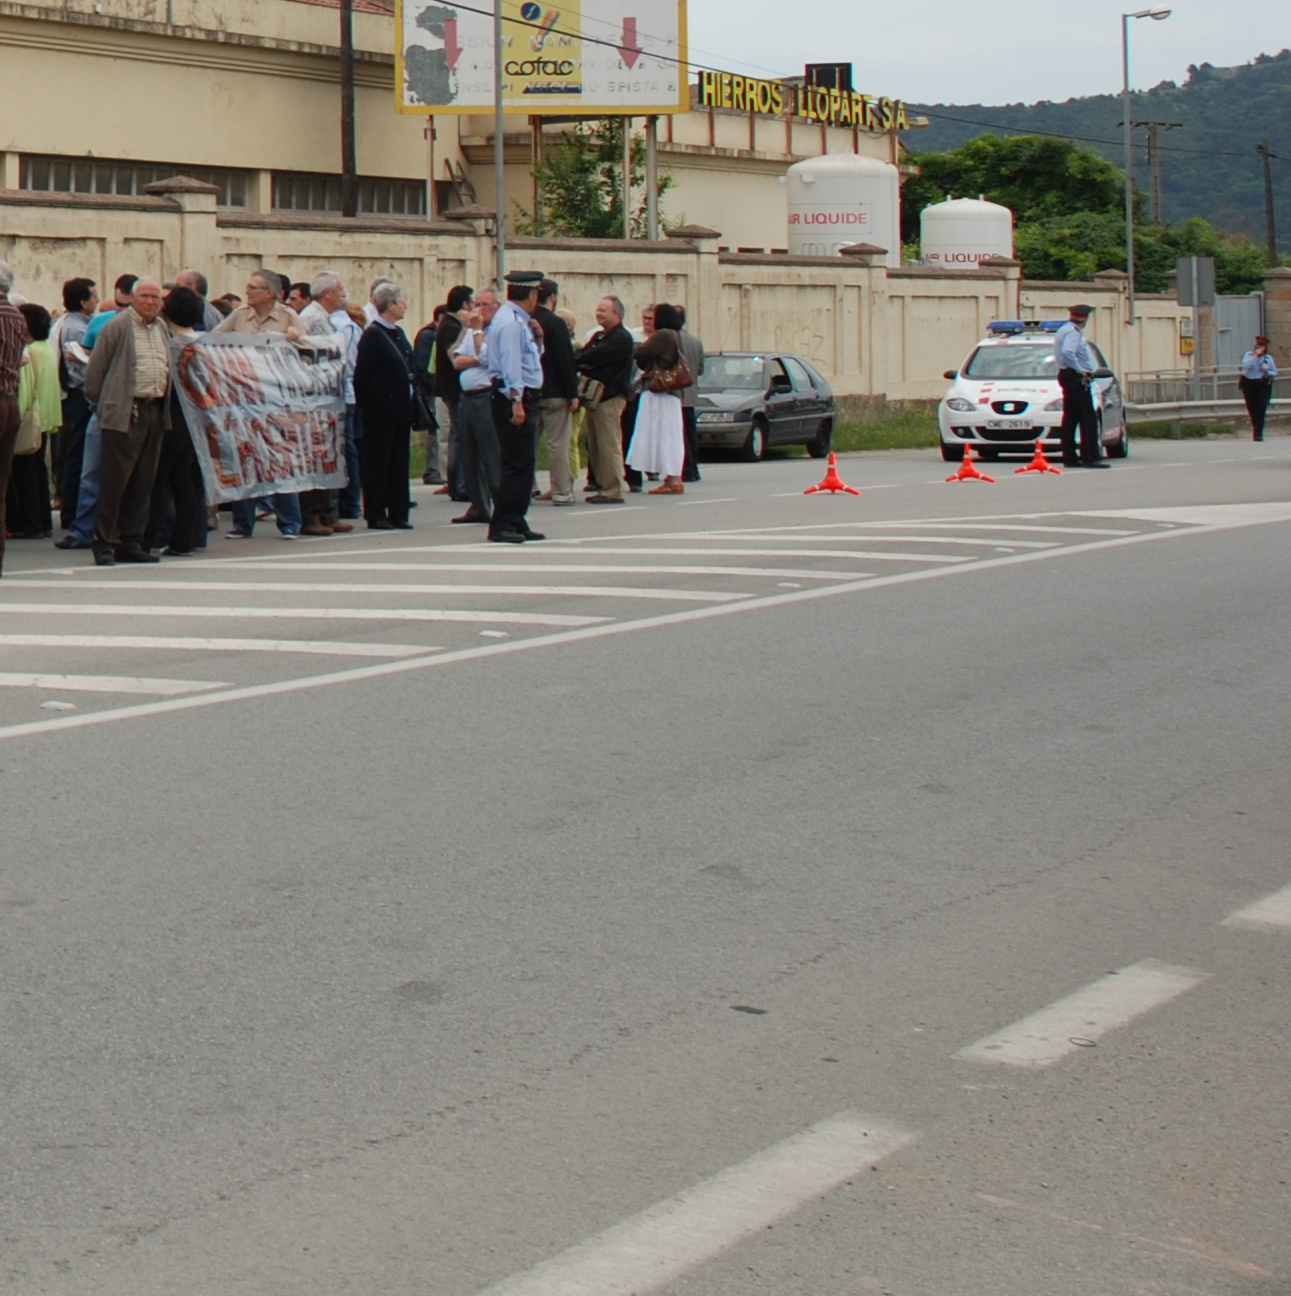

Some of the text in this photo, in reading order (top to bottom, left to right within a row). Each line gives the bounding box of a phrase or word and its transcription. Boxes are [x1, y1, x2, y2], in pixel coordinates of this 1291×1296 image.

[504, 56, 574, 76] cofac
[701, 71, 784, 114] HIERROS
[804, 213, 867, 225] LIQUIDE
[944, 253, 998, 263] LIQUID
